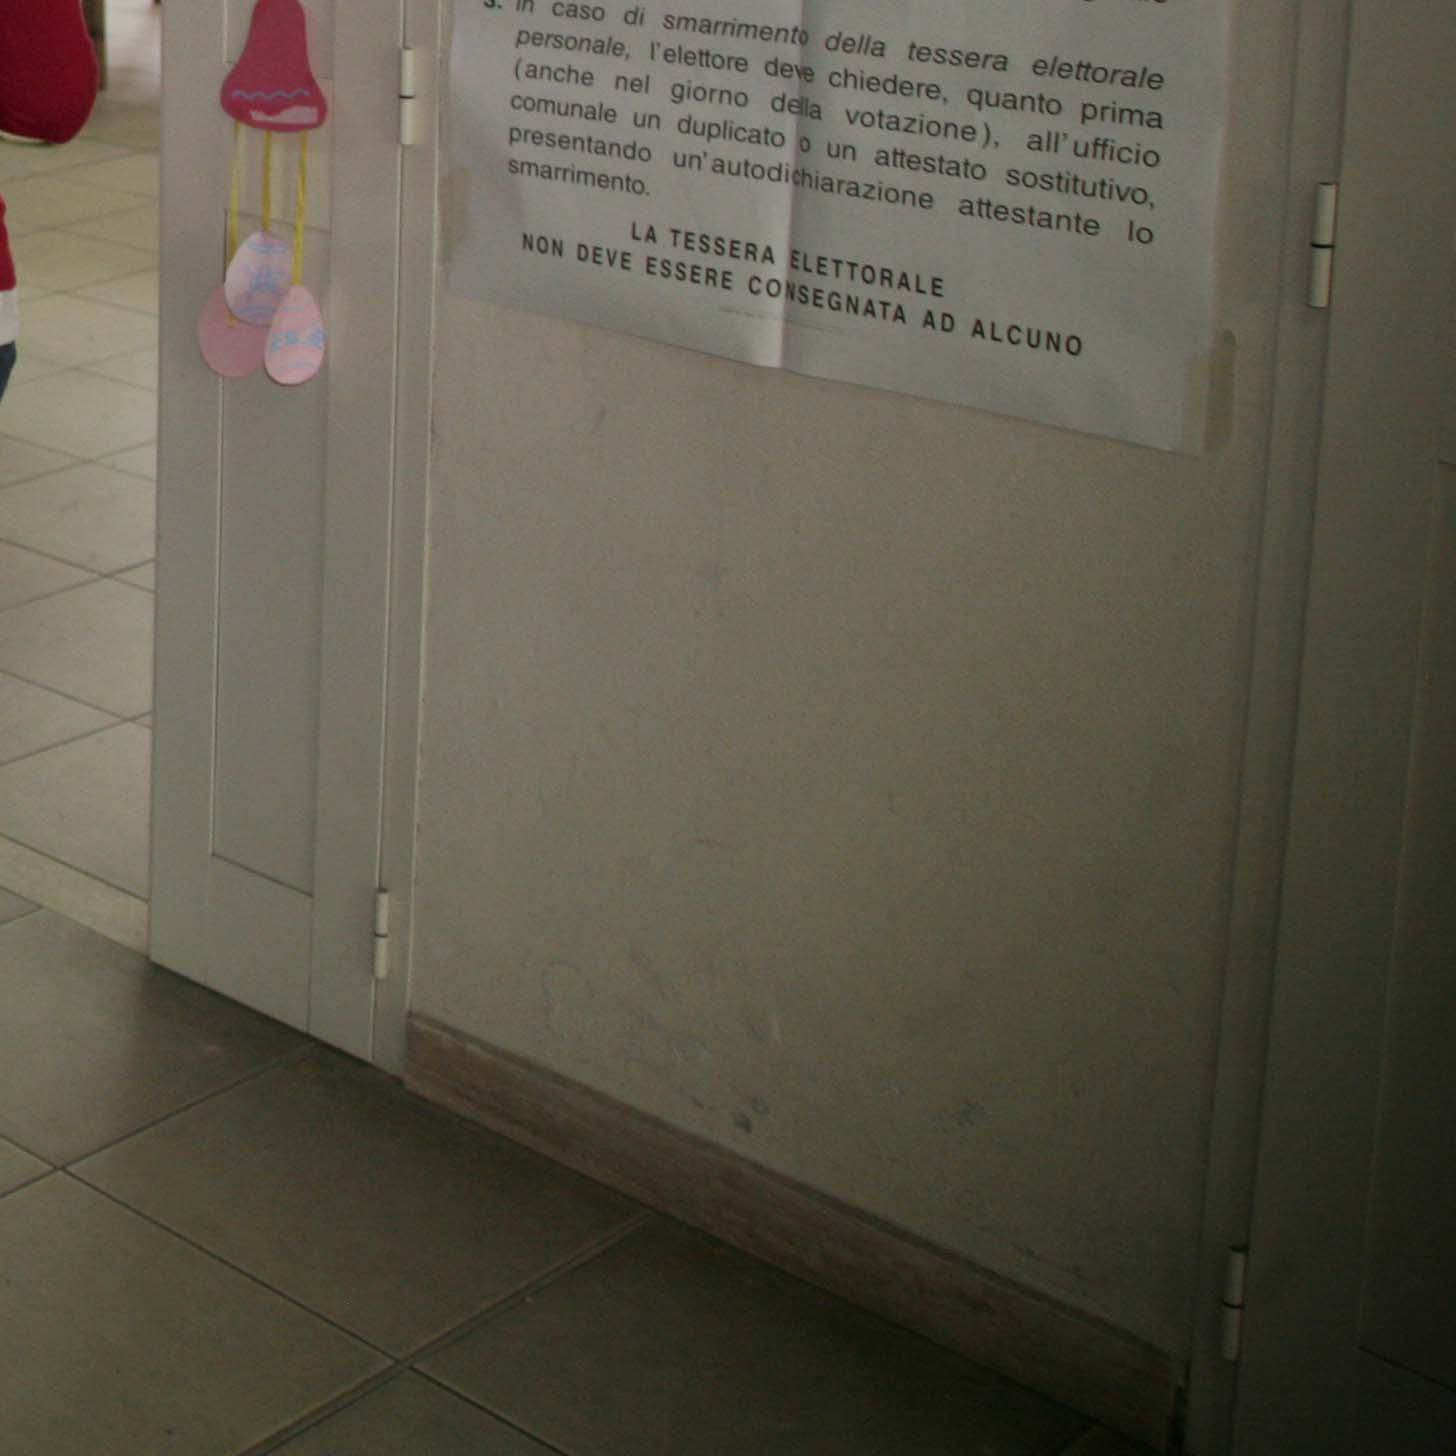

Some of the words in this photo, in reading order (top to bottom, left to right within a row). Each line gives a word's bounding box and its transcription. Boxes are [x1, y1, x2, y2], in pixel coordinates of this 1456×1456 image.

[514, 29, 630, 60] personale,
[763, 56, 816, 84] deve
[827, 67, 949, 105] chiedere,
[966, 87, 1063, 116] quanto
[1080, 100, 1164, 130] prima
[551, 1, 606, 22] caso
[623, 6, 645, 26] di
[662, 13, 810, 48] smarrimento
[824, 31, 887, 58] della
[907, 41, 1009, 72] tessera
[1031, 55, 1165, 91] elettorale
[614, 74, 651, 95] nel
[670, 82, 749, 108] giorno
[770, 92, 823, 121] della
[508, 159, 650, 196] smarrimento.
[508, 126, 653, 163] presentando
[957, 197, 1101, 237] attestante
[1127, 219, 1155, 245] lo
[509, 94, 618, 124] comunale
[632, 111, 661, 130] un
[676, 114, 786, 148] duplicato
[797, 135, 812, 154] o
[826, 141, 857, 162] un
[873, 147, 988, 182] attestato
[1005, 168, 1155, 211] sostitutivo,
[521, 232, 564, 258] NON
[576, 242, 632, 272] DEVE
[645, 255, 733, 291] ESSERE
[747, 274, 907, 325] CONSEGNATA
[921, 309, 956, 334] AD
[970, 318, 1083, 357] ALCUNO
[630, 221, 658, 245] LA
[669, 227, 776, 265] TESSERA
[789, 247, 945, 299] ELETTORALE
